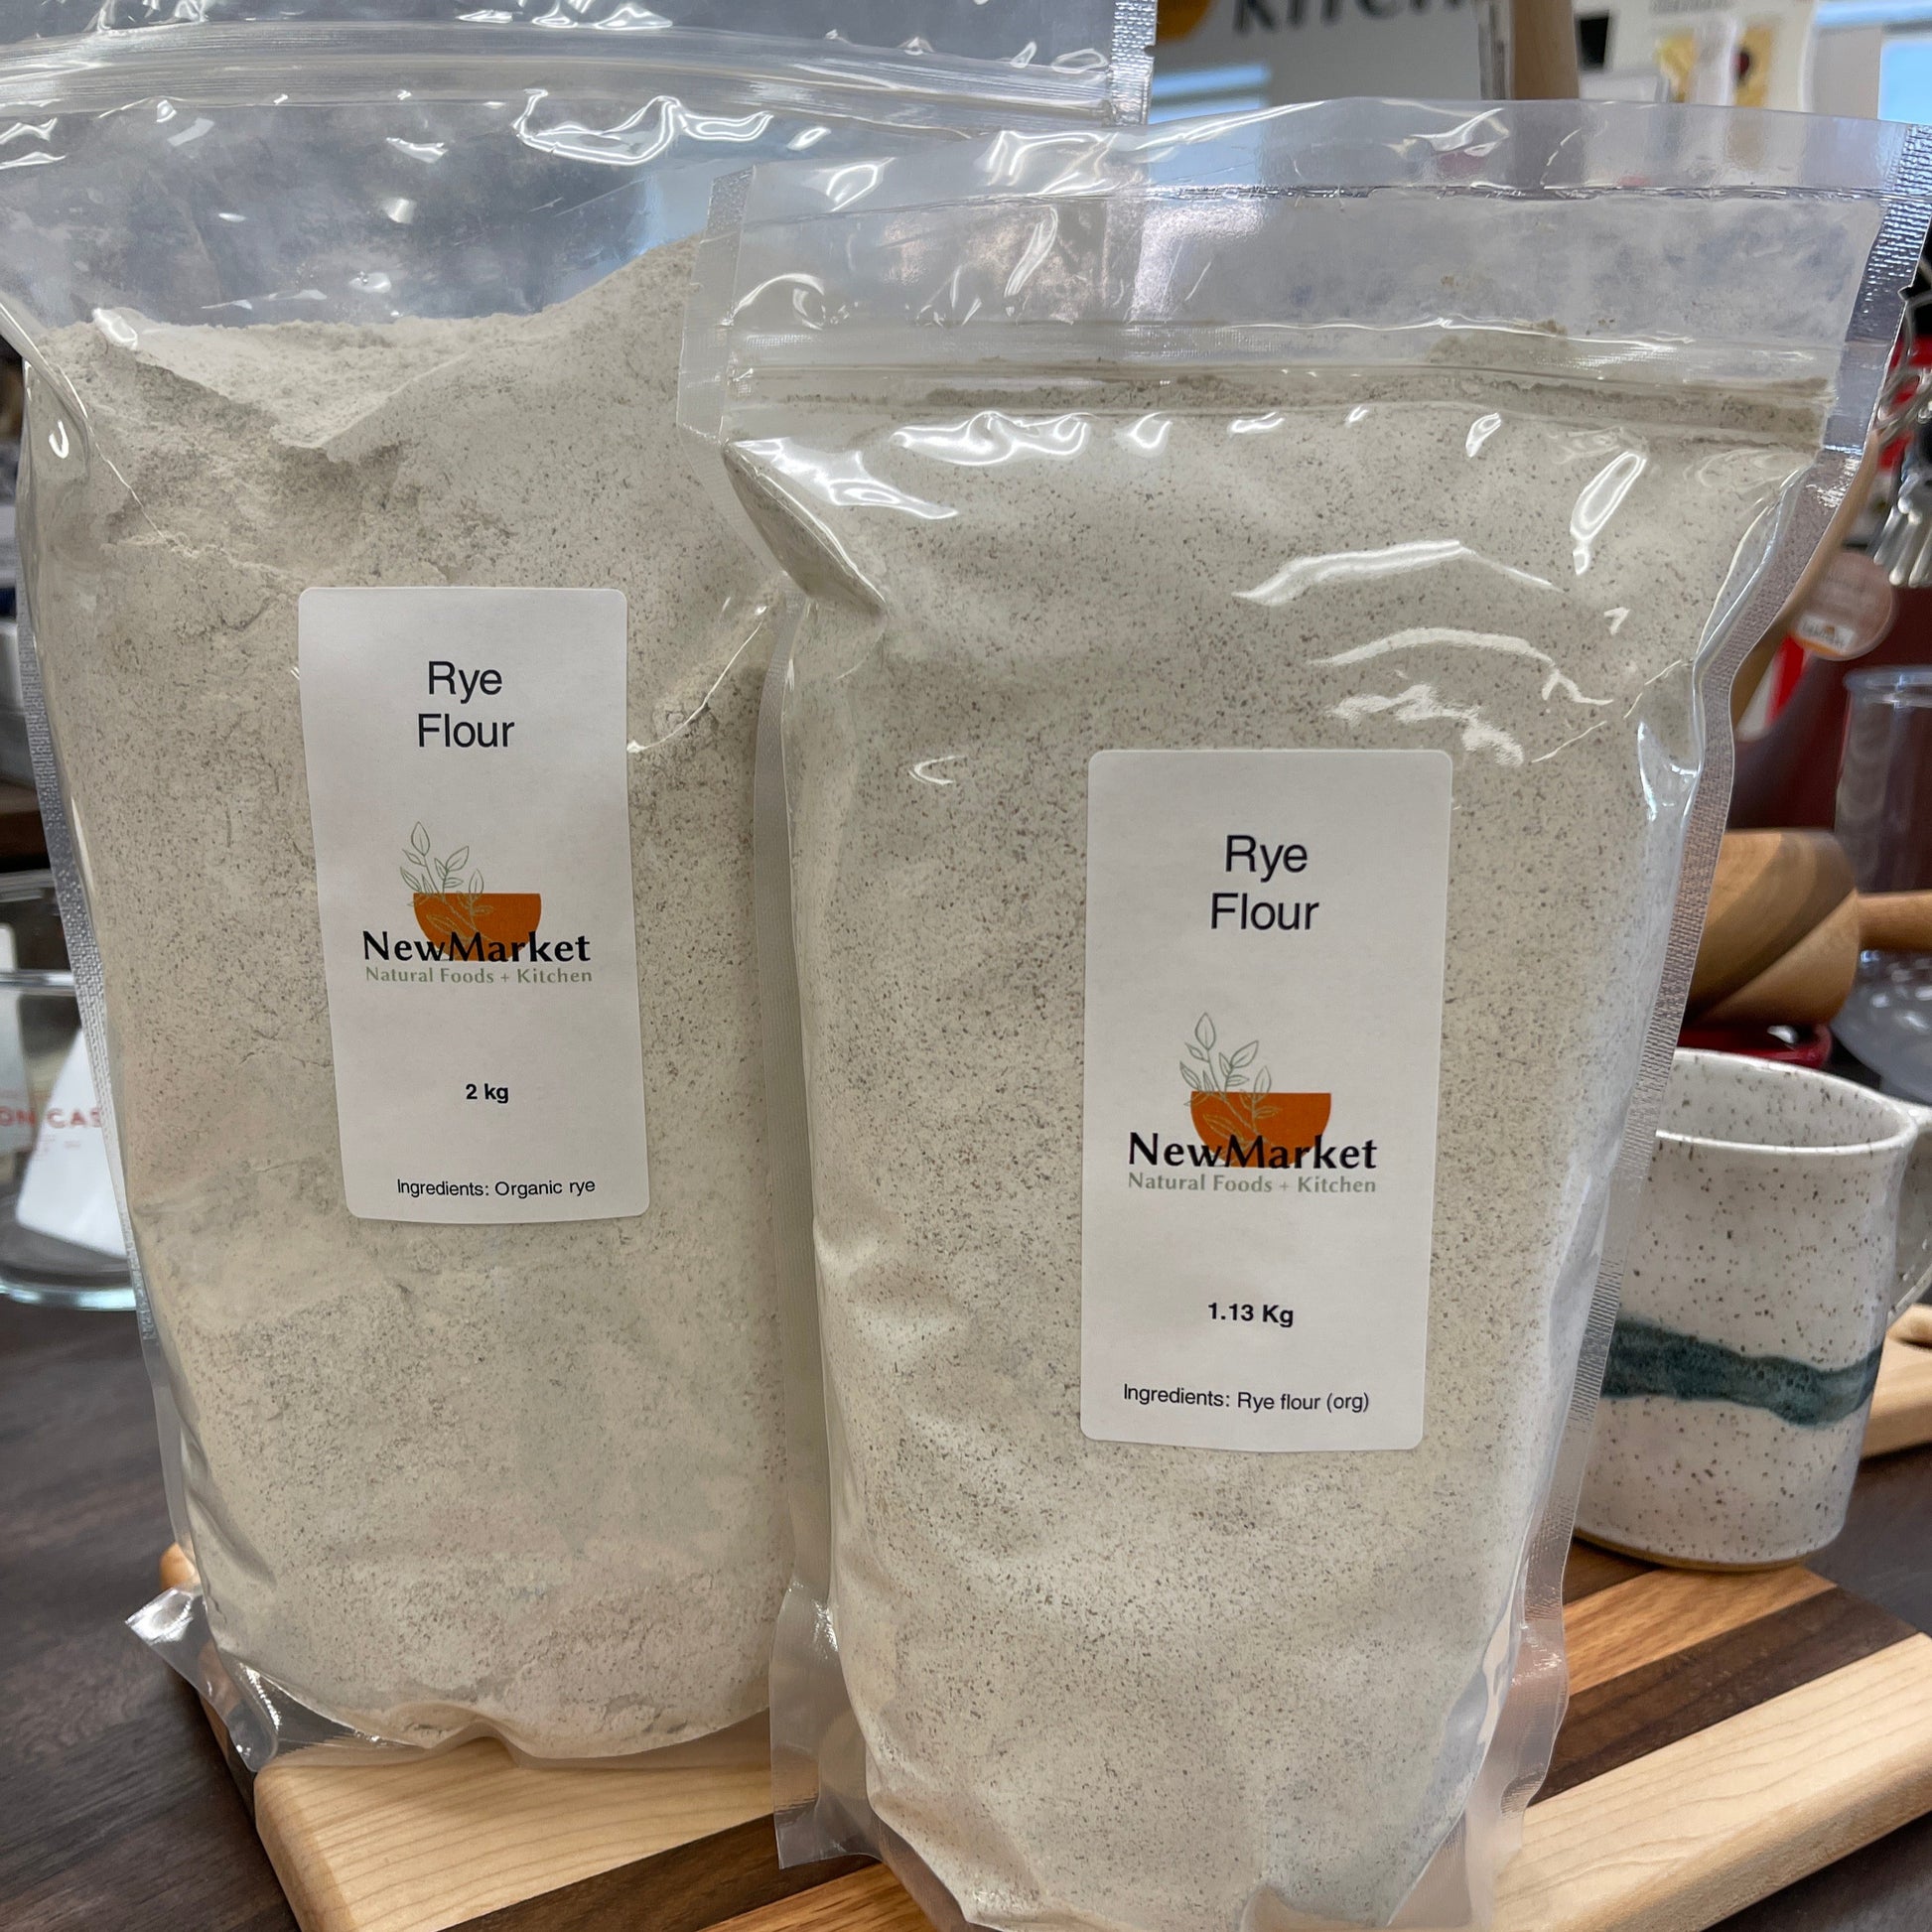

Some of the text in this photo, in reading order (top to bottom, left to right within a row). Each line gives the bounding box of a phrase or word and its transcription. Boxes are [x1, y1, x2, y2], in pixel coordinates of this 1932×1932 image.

[428, 661, 502, 705] Rye
[418, 714, 515, 749] Flour
[1225, 835, 1308, 882] Rye
[1211, 893, 1319, 931] Flour
[362, 930, 592, 963] NewMarket
[365, 966, 434, 983] Natural
[440, 967, 494, 984] Foods
[516, 968, 593, 984] Kitchen
[466, 1083, 509, 1104] 2 kg
[1129, 1132, 1377, 1170] NewMarket
[397, 1178, 596, 1201] Ingredients: Organic rye
[1128, 1172, 1206, 1191] Natural
[1212, 1173, 1273, 1193] Foods
[1298, 1175, 1376, 1193] Kitchen
[1207, 1302, 1294, 1328] 1.13 Kg
[1123, 1383, 1370, 1414] Ingredients: Rye flour (org)
